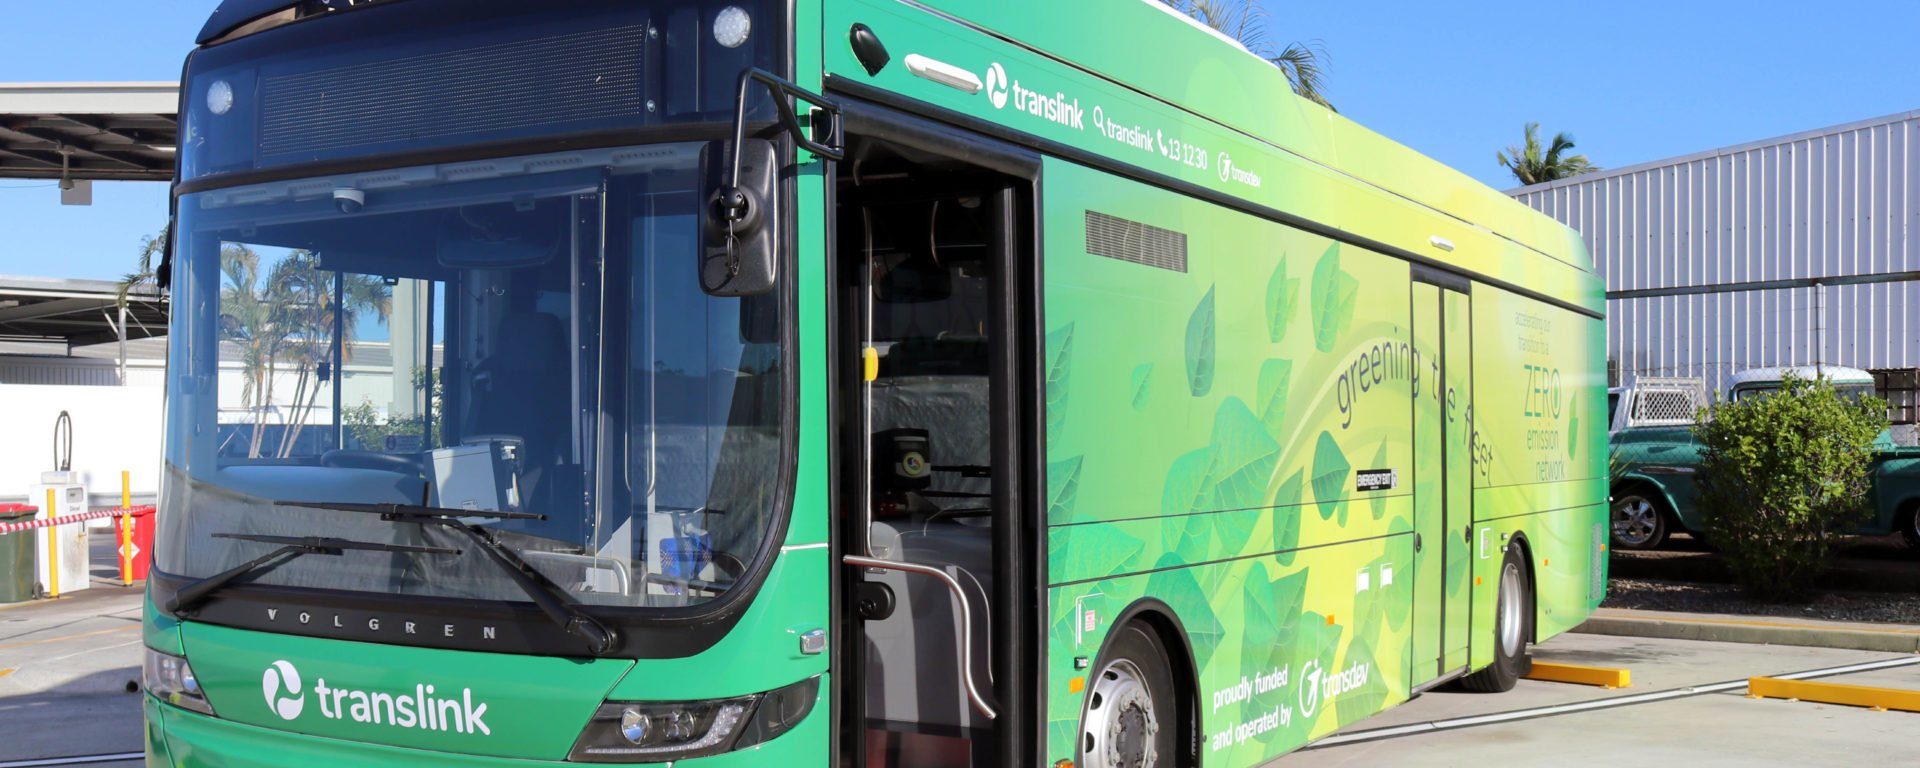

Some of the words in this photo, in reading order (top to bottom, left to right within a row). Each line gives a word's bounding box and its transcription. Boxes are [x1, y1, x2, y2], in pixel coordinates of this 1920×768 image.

[1012, 80, 1084, 131] translink
[1107, 117, 1154, 152] translink
[1168, 138, 1181, 161] 13
[1231, 164, 1261, 188] transdev
[1337, 326, 1421, 430] greening
[1432, 353, 1456, 423] te
[1463, 404, 1494, 486] feet
[1524, 364, 1562, 420] ZERO
[1526, 421, 1559, 451] emission
[1357, 473, 1382, 487] EMERGENCY
[1382, 472, 1391, 485] EXIT
[1535, 454, 1565, 481] network
[267, 608, 496, 640] VOLGREN
[1213, 675, 1253, 714] proudly
[1254, 663, 1288, 695] funded
[1321, 660, 1370, 700] transdev
[314, 677, 491, 736] translink
[1212, 722, 1233, 752] and
[1235, 703, 1279, 746] operated
[1280, 704, 1293, 728] by
